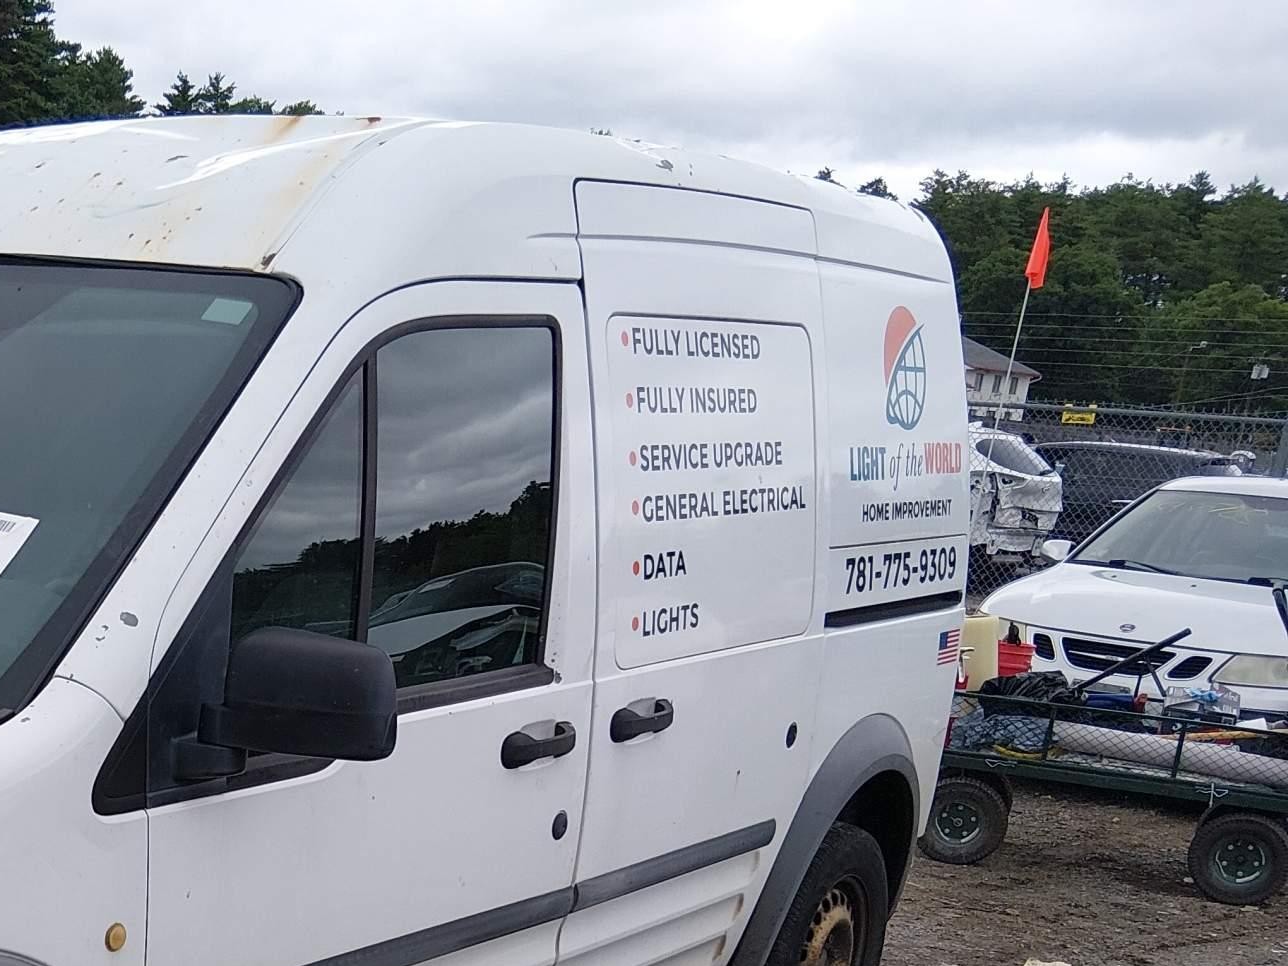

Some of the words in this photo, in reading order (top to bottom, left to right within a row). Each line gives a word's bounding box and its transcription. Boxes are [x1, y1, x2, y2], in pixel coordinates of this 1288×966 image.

[632, 327, 680, 356] FULLY
[687, 331, 760, 360] LICENSED
[637, 386, 685, 414] FULLY
[689, 387, 757, 414] INSURED
[639, 443, 708, 472] SERVICE
[713, 441, 783, 468] UPGRADE
[850, 446, 886, 482] LIGHT
[889, 444, 905, 491] of
[905, 444, 923, 482] the
[924, 443, 962, 475] WORLD
[643, 491, 718, 523] GENERAL
[723, 485, 806, 516] ELECTRICAL
[862, 503, 890, 523] HOME
[892, 499, 952, 521] IMPROVEMENT
[643, 550, 687, 580] DATA
[845, 546, 956, 595] 781-775-9309
[642, 603, 699, 637] LIGHTS
